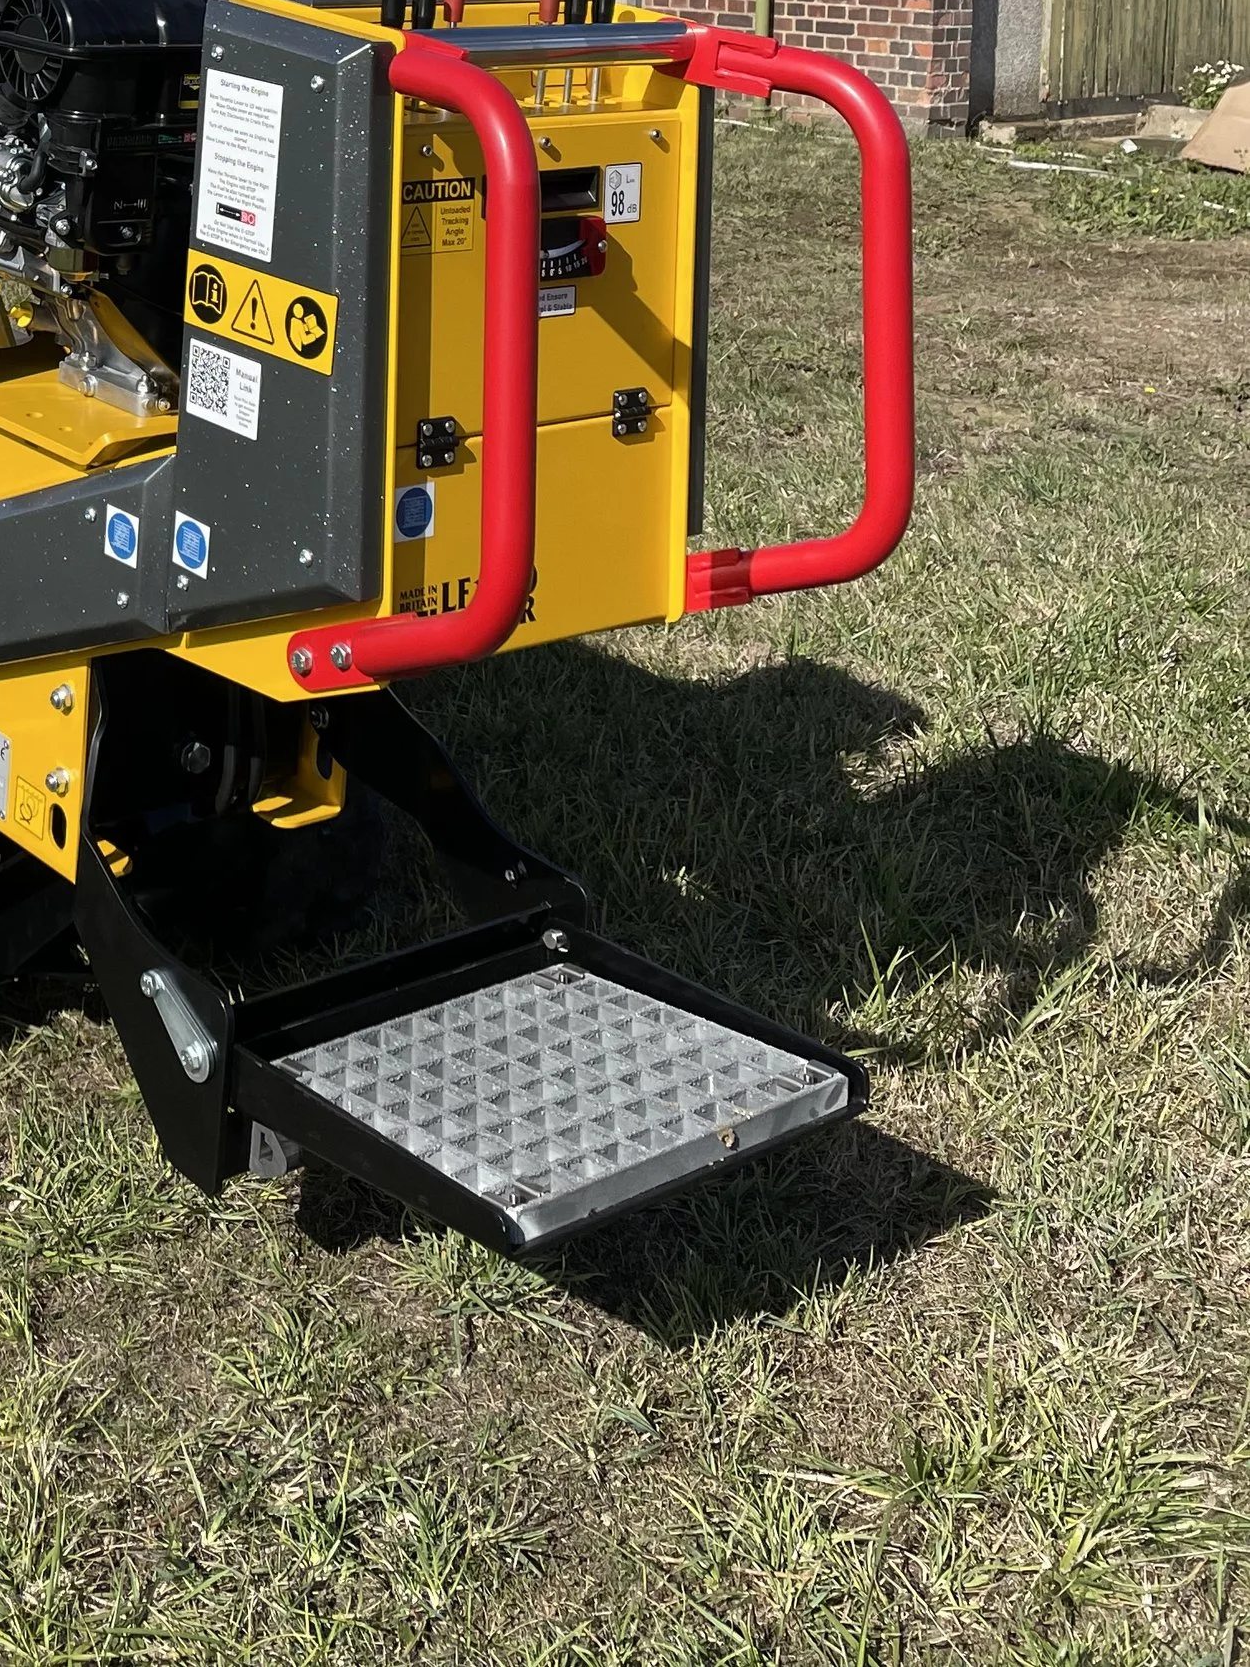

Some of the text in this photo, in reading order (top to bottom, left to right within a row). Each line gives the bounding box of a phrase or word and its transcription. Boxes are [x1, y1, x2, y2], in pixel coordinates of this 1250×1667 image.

[221, 79, 241, 91] Starting
[251, 86, 269, 98] Engine
[214, 153, 264, 174] Stopping the Engine
[403, 180, 471, 201] CAUTION
[440, 206, 471, 215] Unloaded
[611, 190, 637, 216] 98 dB
[441, 217, 469, 226] Tracking
[446, 228, 464, 237] Angle
[442, 238, 455, 247] Max
[236, 368, 258, 384] Manual
[240, 382, 252, 394] Link
[400, 585, 438, 599] MADE IN
[400, 596, 438, 613] BRITAIN
